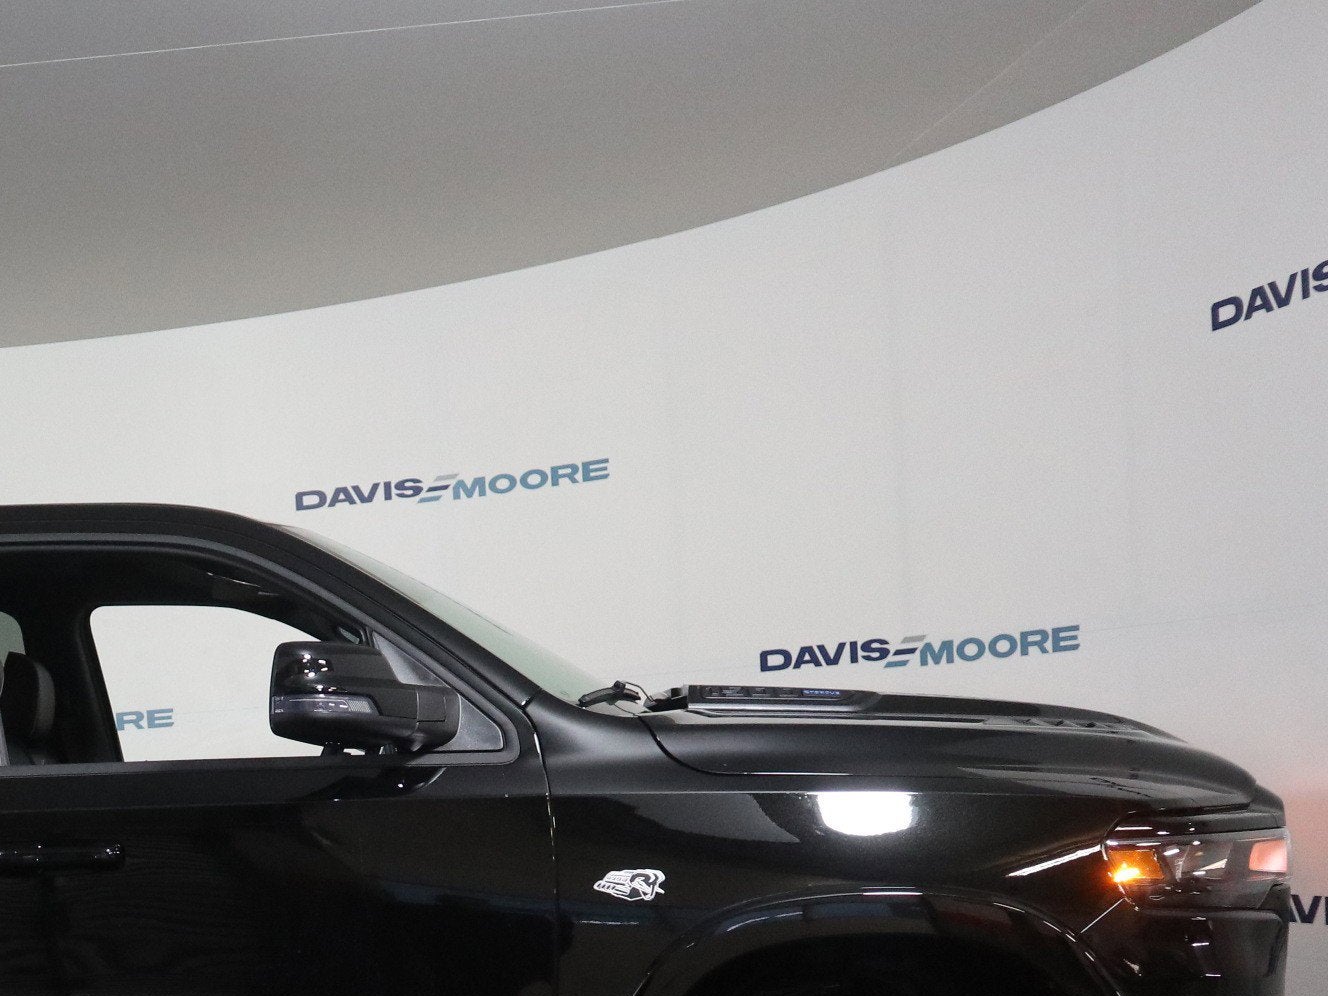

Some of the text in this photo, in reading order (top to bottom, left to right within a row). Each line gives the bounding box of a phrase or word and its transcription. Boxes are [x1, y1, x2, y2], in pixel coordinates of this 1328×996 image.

[1211, 259, 1328, 331] DAVIS
[295, 458, 610, 511] DAVIS MOORE
[760, 624, 1080, 672] DAVIS MOORE
